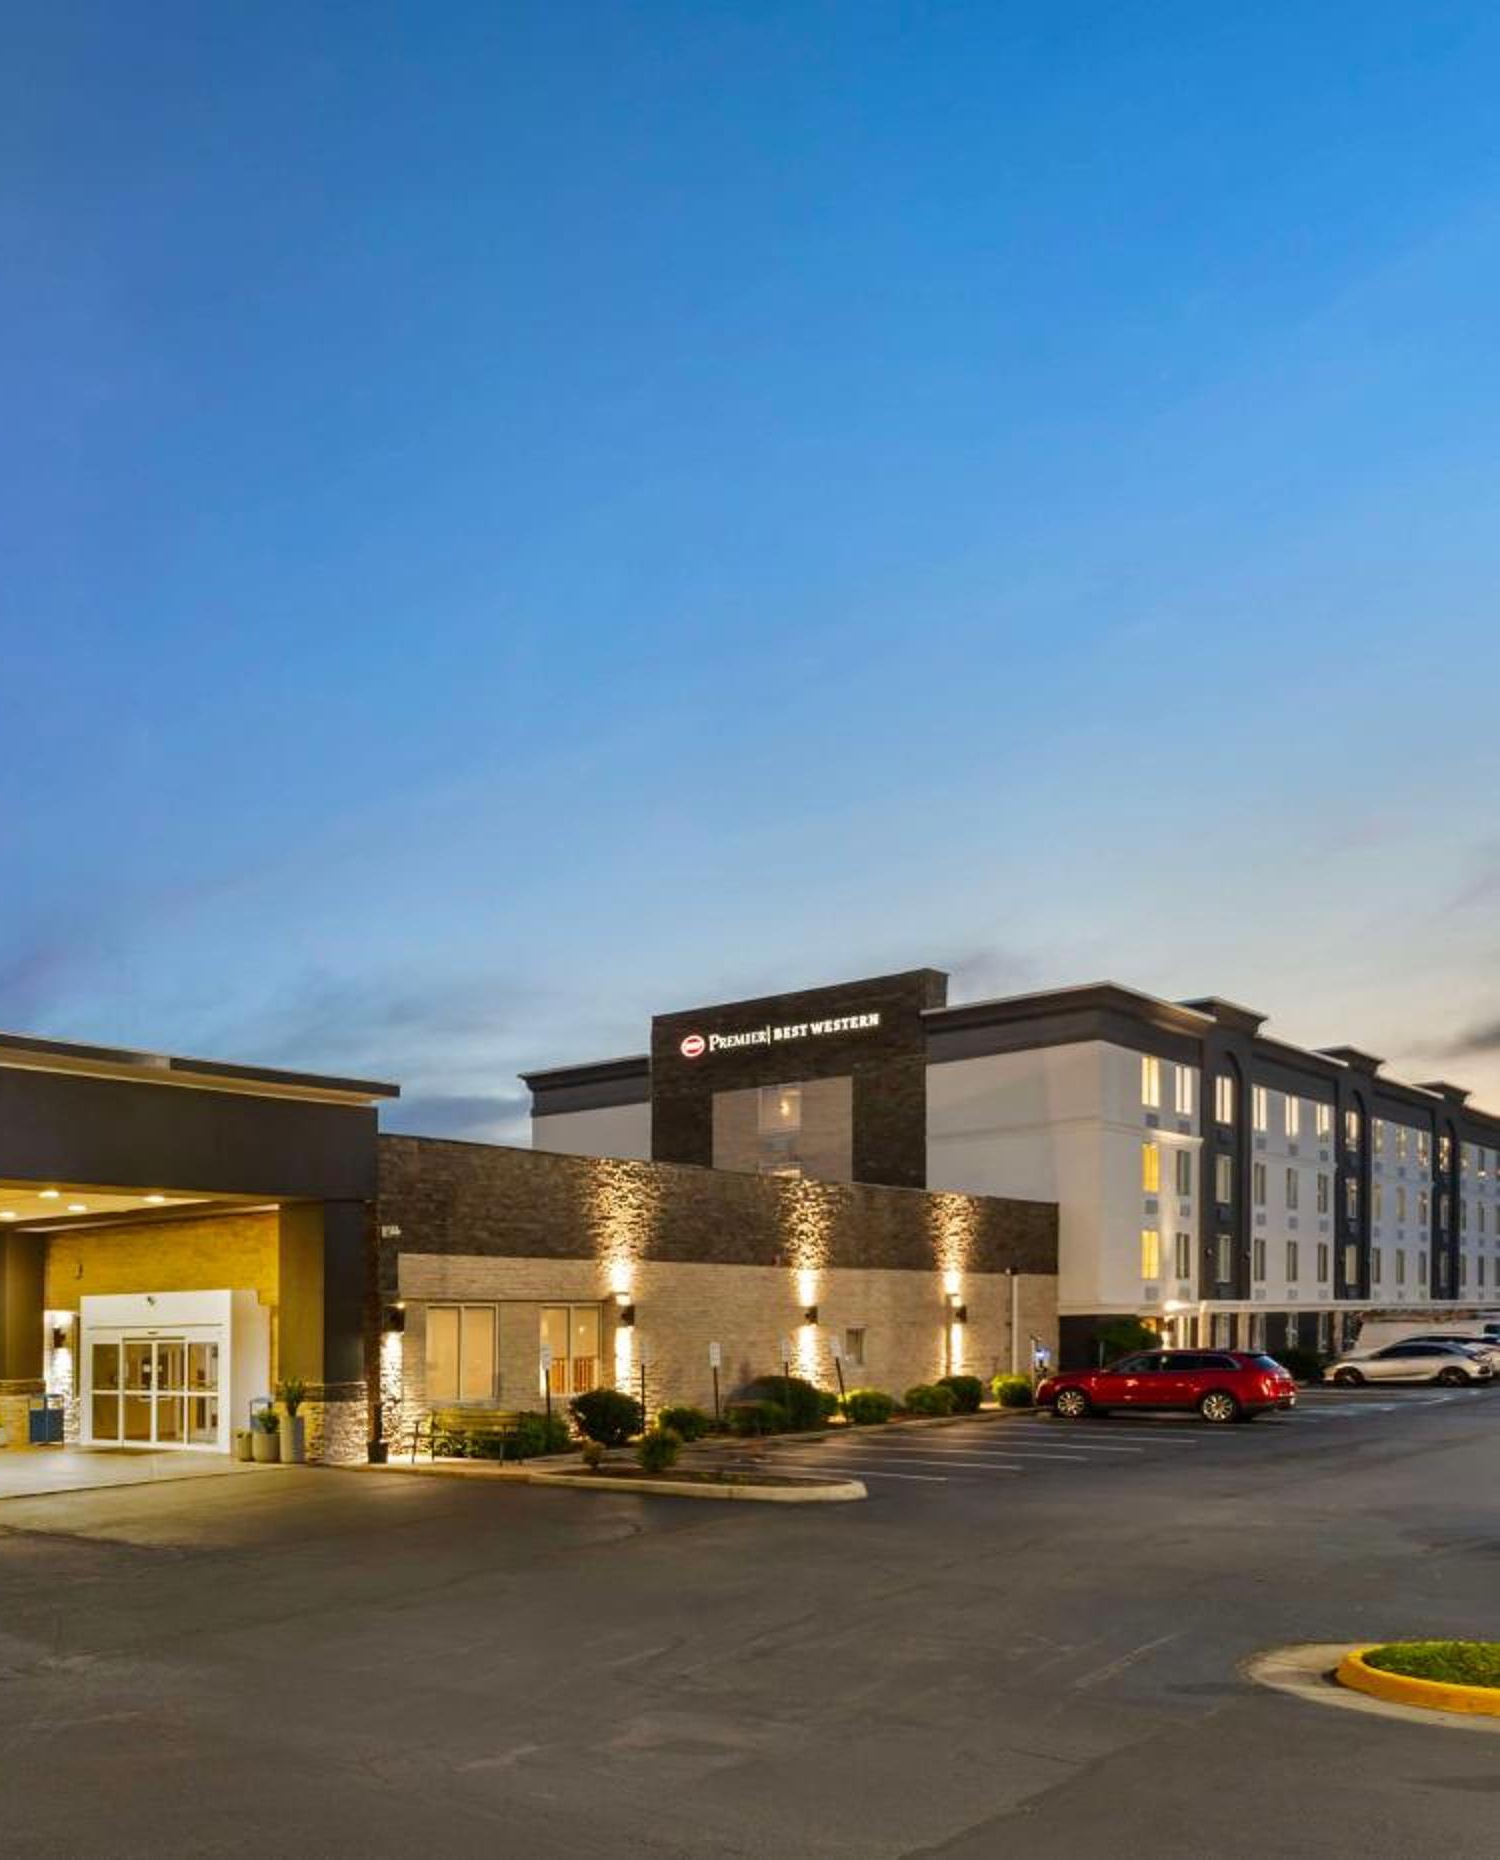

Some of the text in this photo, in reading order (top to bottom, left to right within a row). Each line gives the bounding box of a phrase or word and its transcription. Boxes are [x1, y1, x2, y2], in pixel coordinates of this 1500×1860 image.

[709, 1031, 766, 1052] PREMIER
[773, 1024, 808, 1041] BEST
[810, 1013, 880, 1034] WESTERN
